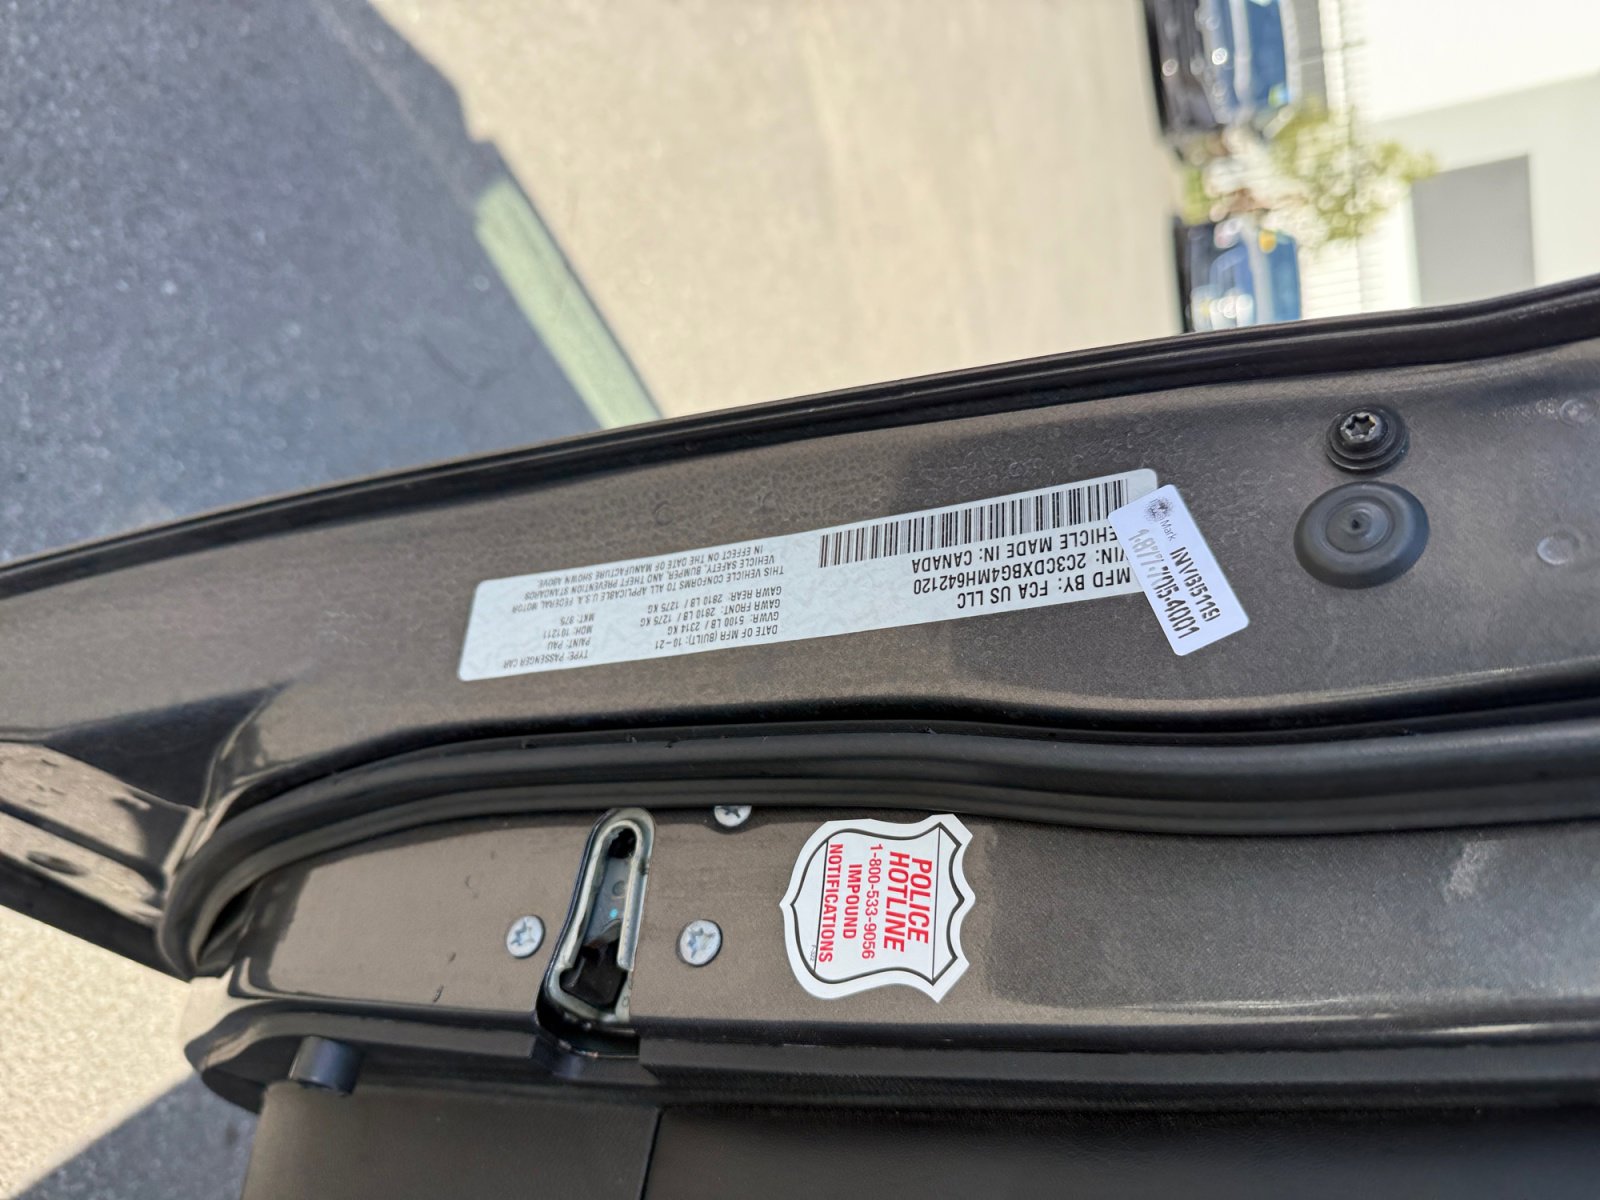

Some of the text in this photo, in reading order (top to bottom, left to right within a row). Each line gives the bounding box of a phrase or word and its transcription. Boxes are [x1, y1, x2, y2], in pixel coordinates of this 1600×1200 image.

[722, 546, 751, 559] EFFECT
[754, 544, 763, 554] IN
[911, 525, 1115, 573] EHICLE MADE IN: CANADA
[667, 557, 686, 568] DATE
[689, 554, 704, 565] THE
[707, 551, 719, 562] ON
[739, 554, 774, 568] VEHICLE
[594, 562, 652, 579] MANUFACTURE
[655, 560, 665, 570] OF
[763, 564, 784, 577] THIS
[564, 571, 592, 584] SHOWN
[647, 572, 663, 583] AND
[726, 567, 760, 582] VEHICLE
[913, 552, 1085, 594] 2C3CDXBG4MH642120
[571, 578, 617, 594] PREVENTION
[620, 574, 644, 587] THEFT
[667, 581, 675, 591] TO
[679, 573, 723, 589] CONFORMS
[524, 586, 568, 601] STANDARDS
[600, 585, 646, 601] APPLICABLE
[650, 583, 664, 594] ALL
[755, 585, 781, 598] GAWR
[957, 566, 1130, 609] MFD BY: FCA US LLC
[703, 593, 722, 605] 2810
[728, 589, 752, 601] REAR:
[511, 601, 537, 614] MOTOR
[540, 596, 573, 610] FEDERAL
[647, 603, 658, 613] KG
[660, 600, 678, 611] 1275
[720, 601, 751, 615] FRONT:
[754, 597, 780, 611] GAWR
[696, 606, 715, 618] 2810
[750, 610, 778, 624] GVWR:
[640, 616, 650, 626] KG
[653, 613, 671, 625] 1275
[724, 615, 744, 627] 5100
[667, 625, 677, 635] KG
[681, 621, 699, 633] 2314
[741, 627, 752, 638] OF
[755, 624, 777, 637] DATE
[685, 631, 717, 645] (BUILT):
[720, 629, 738, 641] MFR
[503, 658, 518, 669] CAR
[519, 651, 564, 667] PASSENGER
[818, 843, 844, 963] NOTIFICATIONS
[842, 863, 863, 939] IMPOUND
[861, 843, 883, 960] 1-800-533-9056
[883, 851, 910, 953] HOTLINE
[907, 857, 933, 944] POLICE
